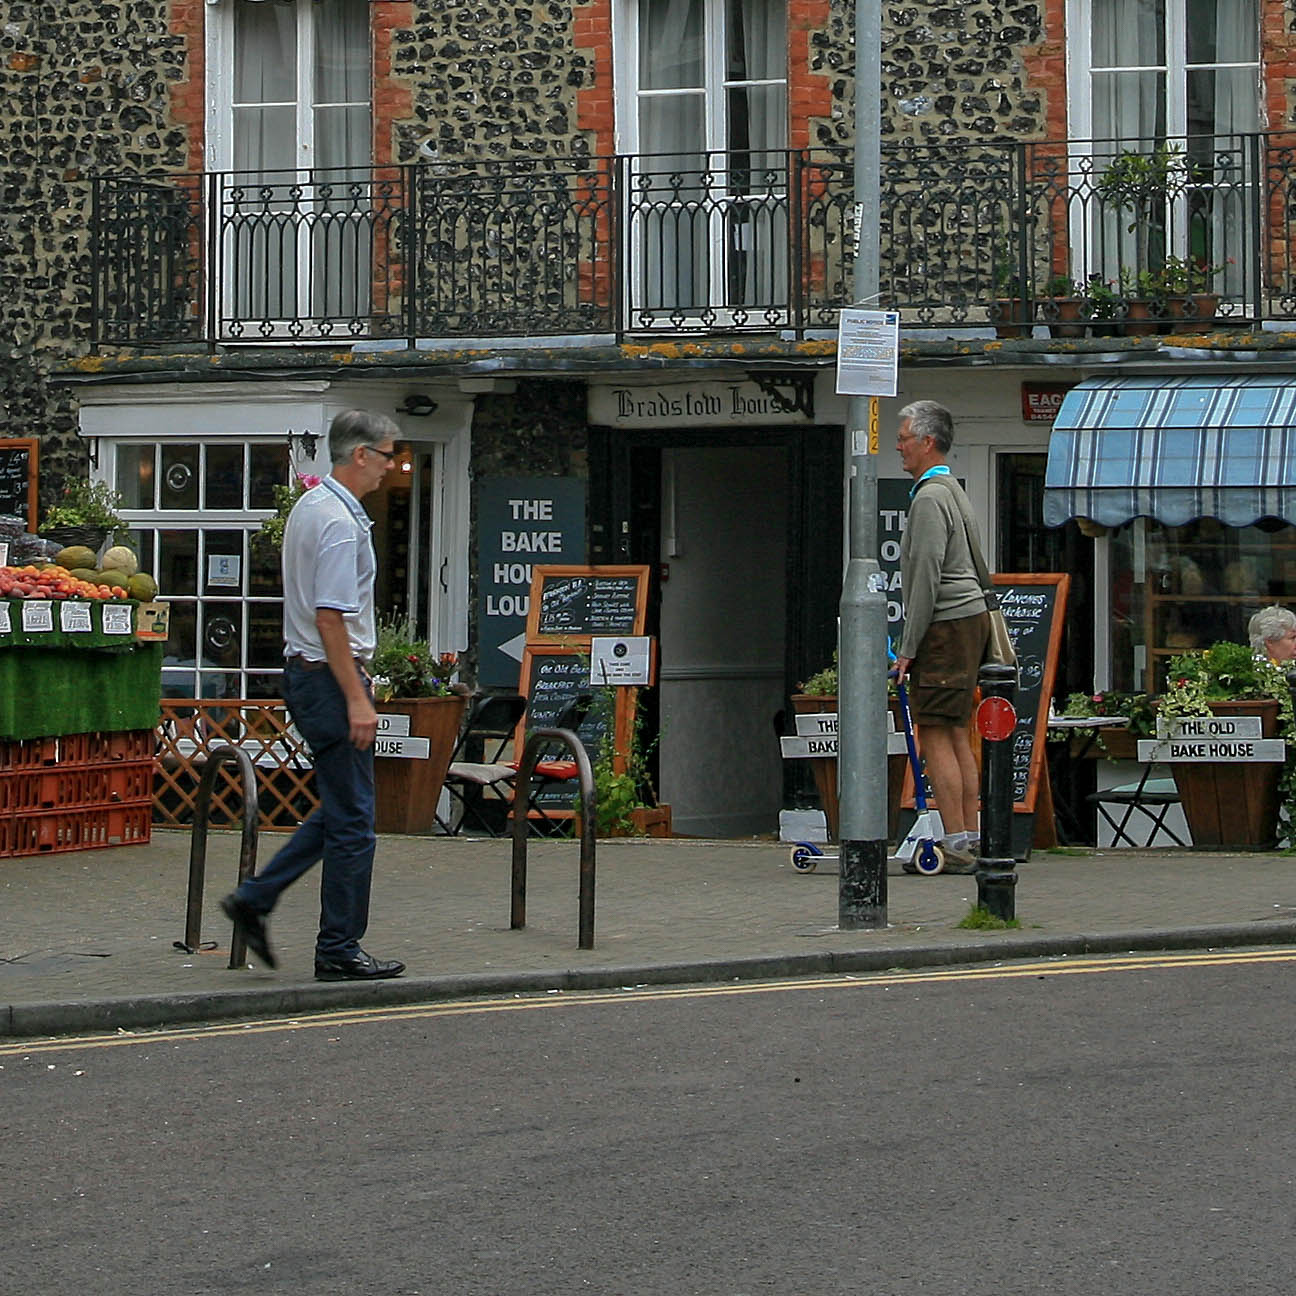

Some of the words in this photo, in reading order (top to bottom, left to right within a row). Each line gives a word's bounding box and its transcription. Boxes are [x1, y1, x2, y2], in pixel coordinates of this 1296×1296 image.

[612, 389, 722, 423] Bradstow
[1028, 393, 1065, 406] EAG
[509, 500, 553, 520] THE
[502, 531, 562, 552] BAKE
[1208, 722, 1236, 735] OLD
[1170, 745, 1206, 757] BAKE
[1209, 744, 1254, 757] HOUSE
